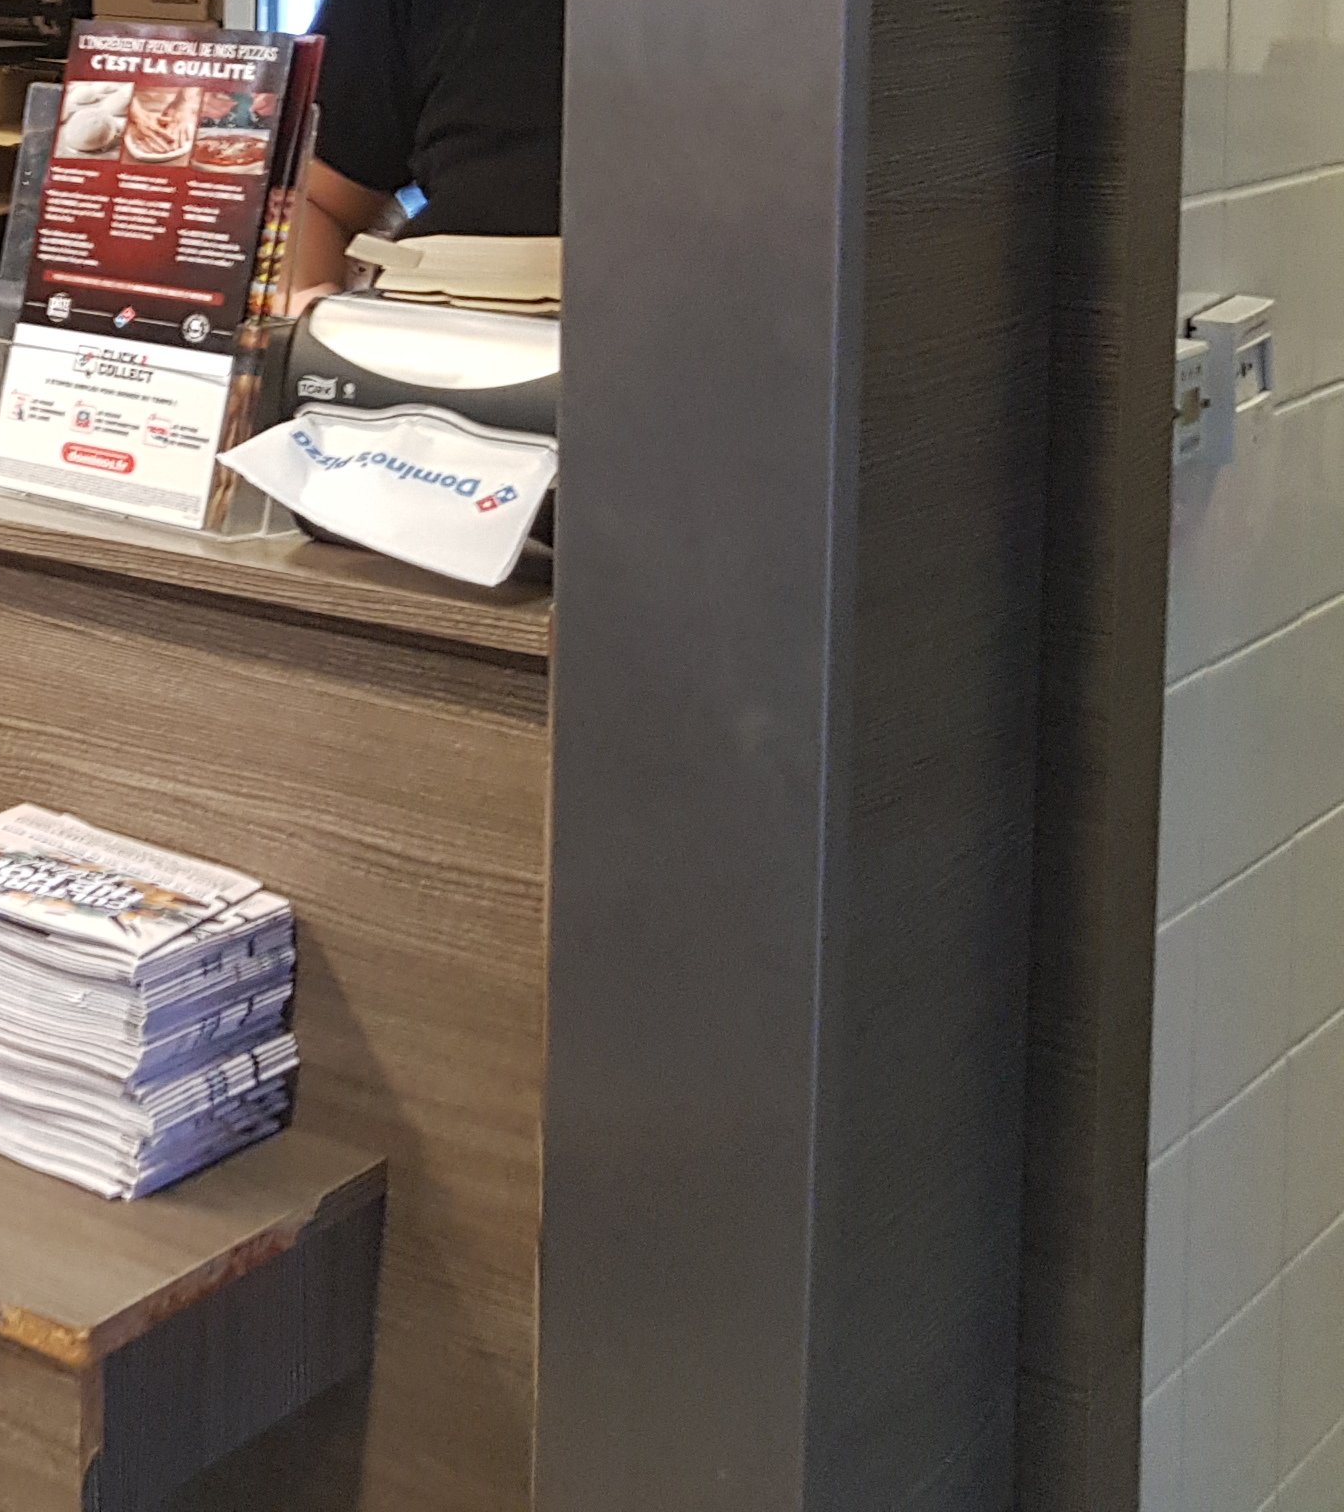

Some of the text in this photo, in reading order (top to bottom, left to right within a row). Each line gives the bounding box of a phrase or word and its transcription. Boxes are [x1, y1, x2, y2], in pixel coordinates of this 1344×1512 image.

[237, 44, 279, 62] PIZZAS
[90, 54, 257, 81] C'EST LA QUALITÉ
[101, 349, 138, 365] CLICK
[97, 363, 154, 384] COLLECT
[356, 451, 482, 498] Domino's
